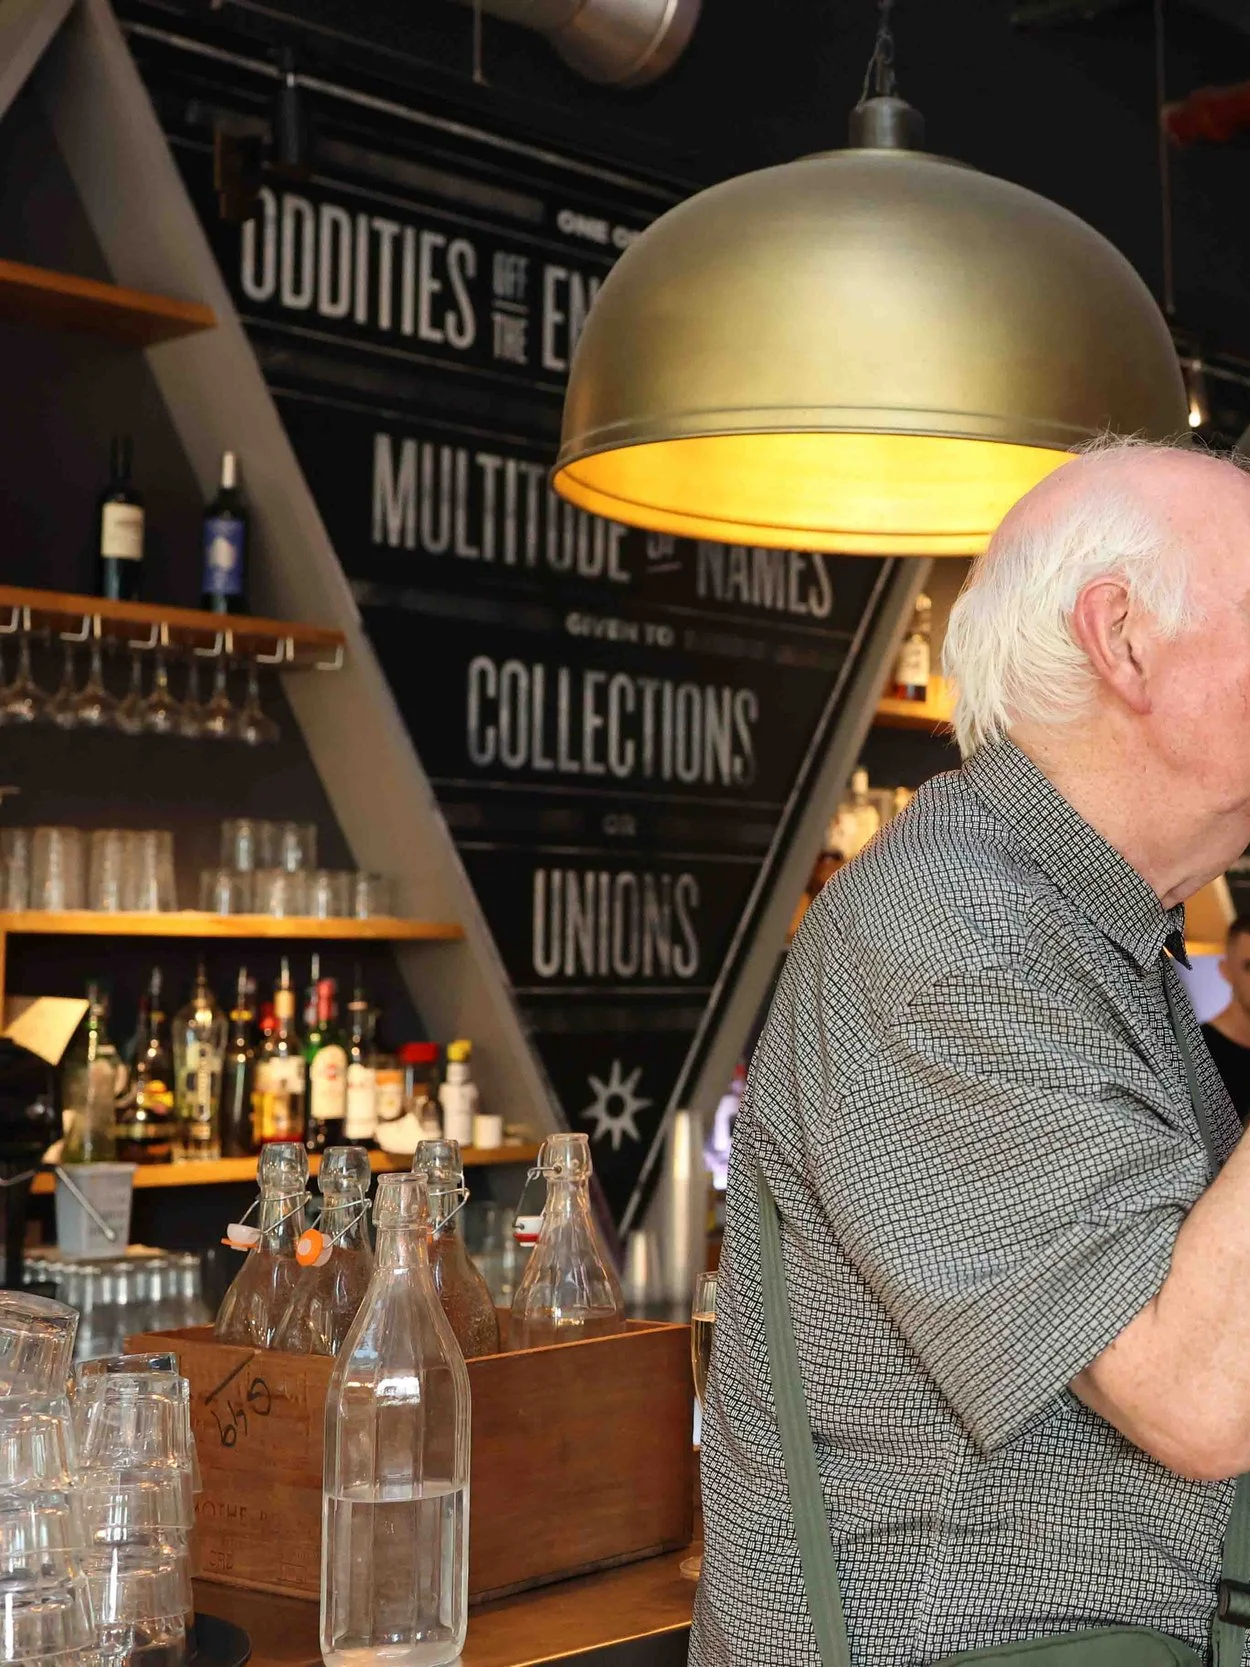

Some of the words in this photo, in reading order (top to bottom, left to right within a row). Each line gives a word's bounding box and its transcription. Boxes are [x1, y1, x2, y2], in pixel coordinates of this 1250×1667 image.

[241, 184, 477, 350] ODDITIES
[556, 209, 611, 245] ONE
[490, 311, 529, 366] THE
[542, 263, 602, 372] EN
[372, 432, 632, 584] MULTITUDE
[695, 540, 834, 620] NAMES
[565, 611, 638, 643] GIVEN
[645, 623, 675, 648] TO
[467, 655, 760, 786] COLLECTIONS
[532, 867, 699, 979] UNIONS
